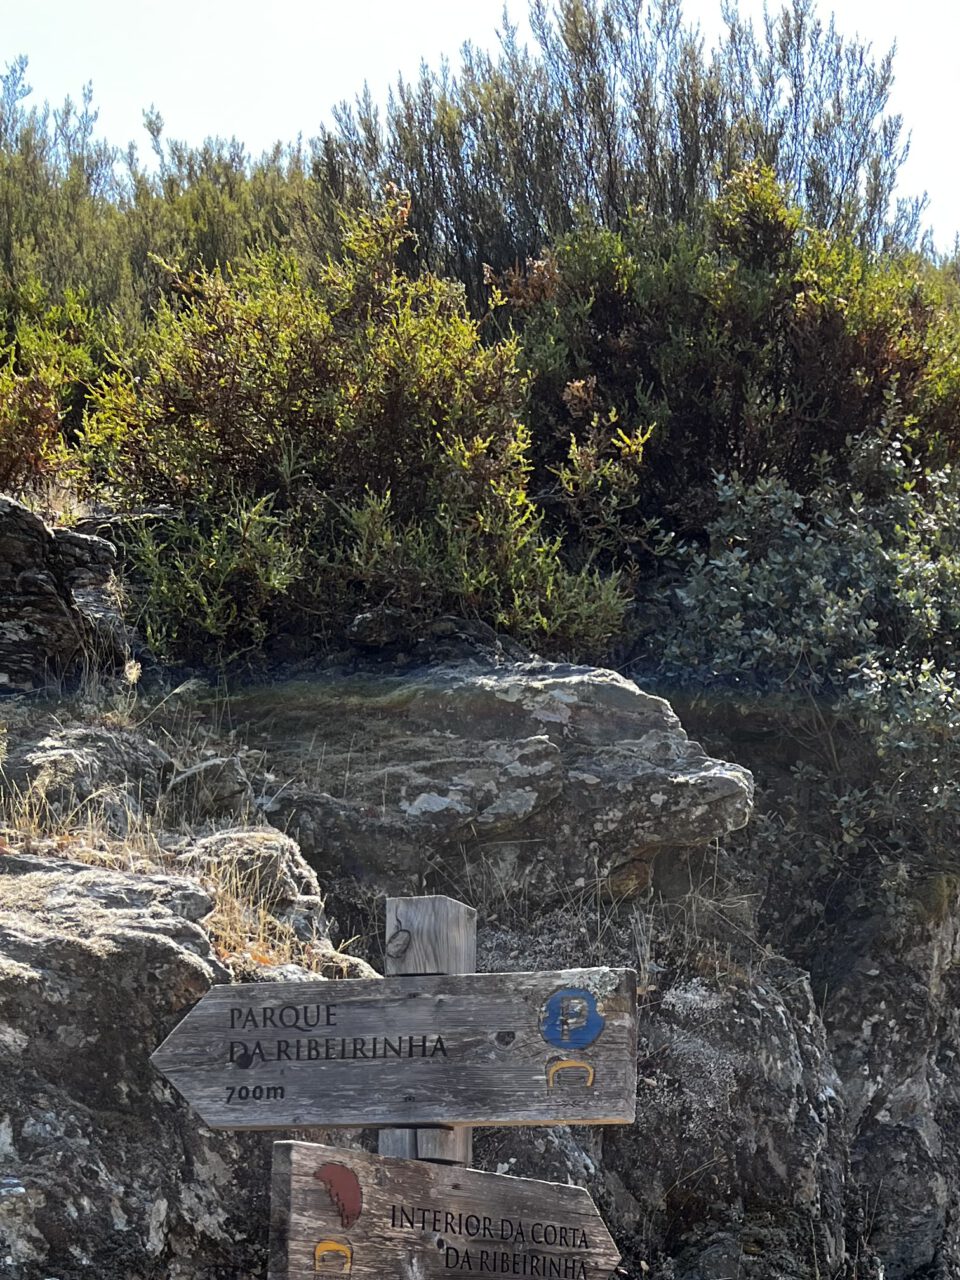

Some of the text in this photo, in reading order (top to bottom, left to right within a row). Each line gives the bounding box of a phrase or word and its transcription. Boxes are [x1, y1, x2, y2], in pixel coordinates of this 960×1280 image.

[230, 1004, 337, 1032] PARQUE
[560, 995, 588, 1042] P
[229, 1035, 448, 1063] DA RIBEIRINHA
[225, 1085, 285, 1105] 700m
[391, 1205, 589, 1249] INTERIOR DA CORTA
[445, 1246, 588, 1280] DA RIBEIRINHA
